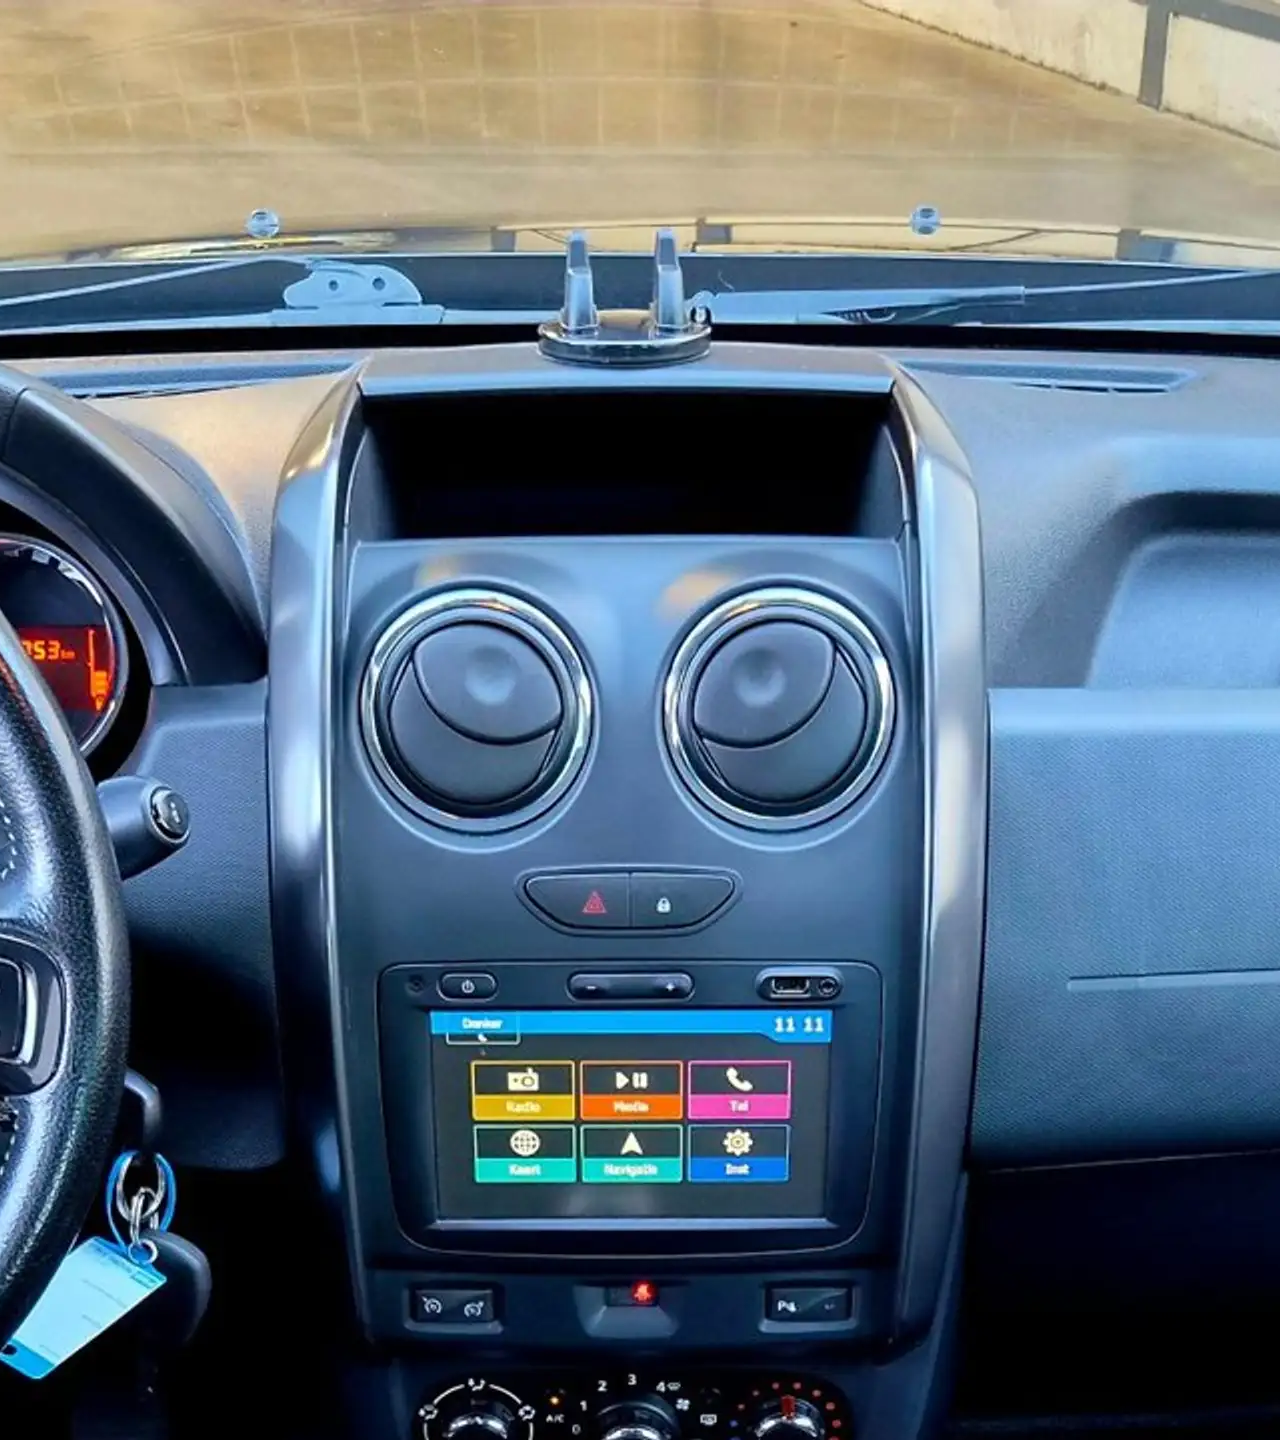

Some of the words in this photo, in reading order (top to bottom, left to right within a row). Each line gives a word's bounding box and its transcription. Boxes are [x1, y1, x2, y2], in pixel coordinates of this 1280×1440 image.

[506, 1101, 542, 1113] Radio
[613, 1100, 649, 1113] Media
[730, 1101, 749, 1112] Tel
[627, 1374, 637, 1385] 3
[597, 1380, 608, 1392] 2
[655, 1381, 666, 1392] 4
